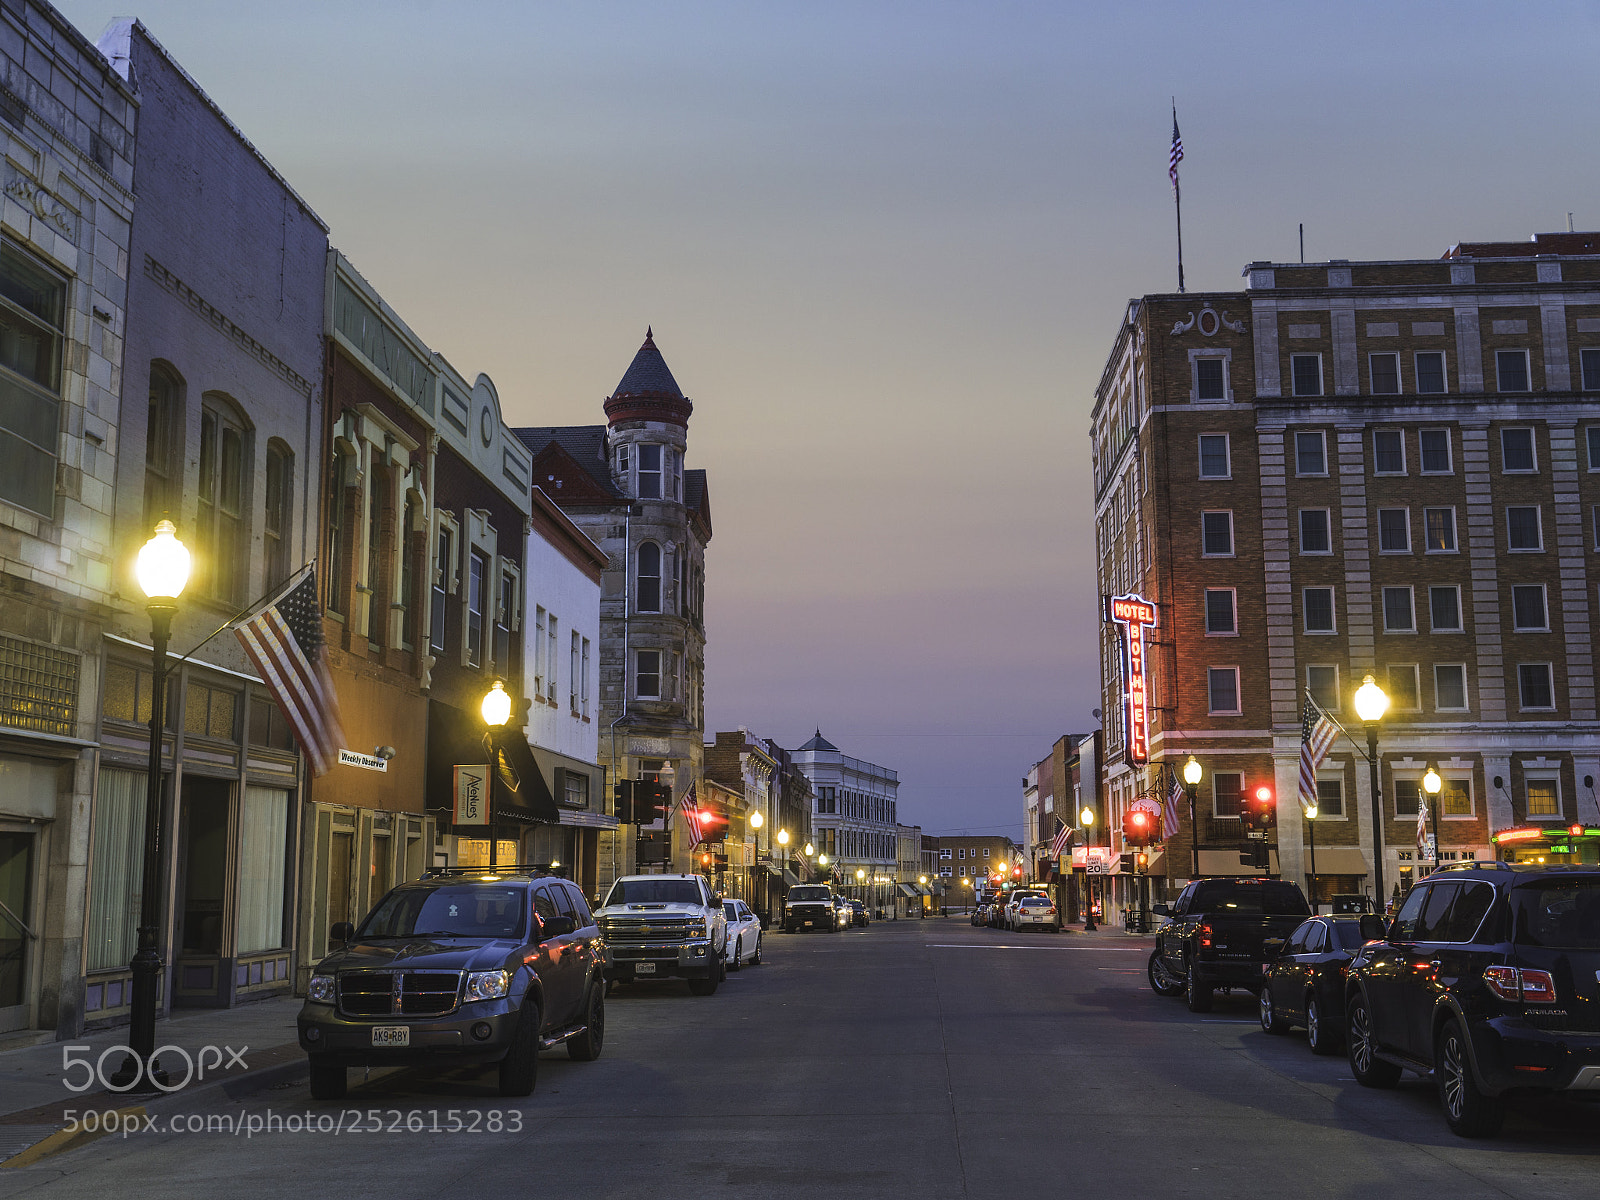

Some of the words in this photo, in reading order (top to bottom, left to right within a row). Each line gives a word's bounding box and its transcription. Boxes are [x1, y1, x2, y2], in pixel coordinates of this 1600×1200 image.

[1115, 602, 1153, 621] HOTEL
[1130, 624, 1145, 757] BOTHWELL
[341, 753, 361, 765] Weekly
[362, 757, 384, 768] Observer
[471, 842, 506, 856] IRIH
[1087, 865, 1101, 873] 20
